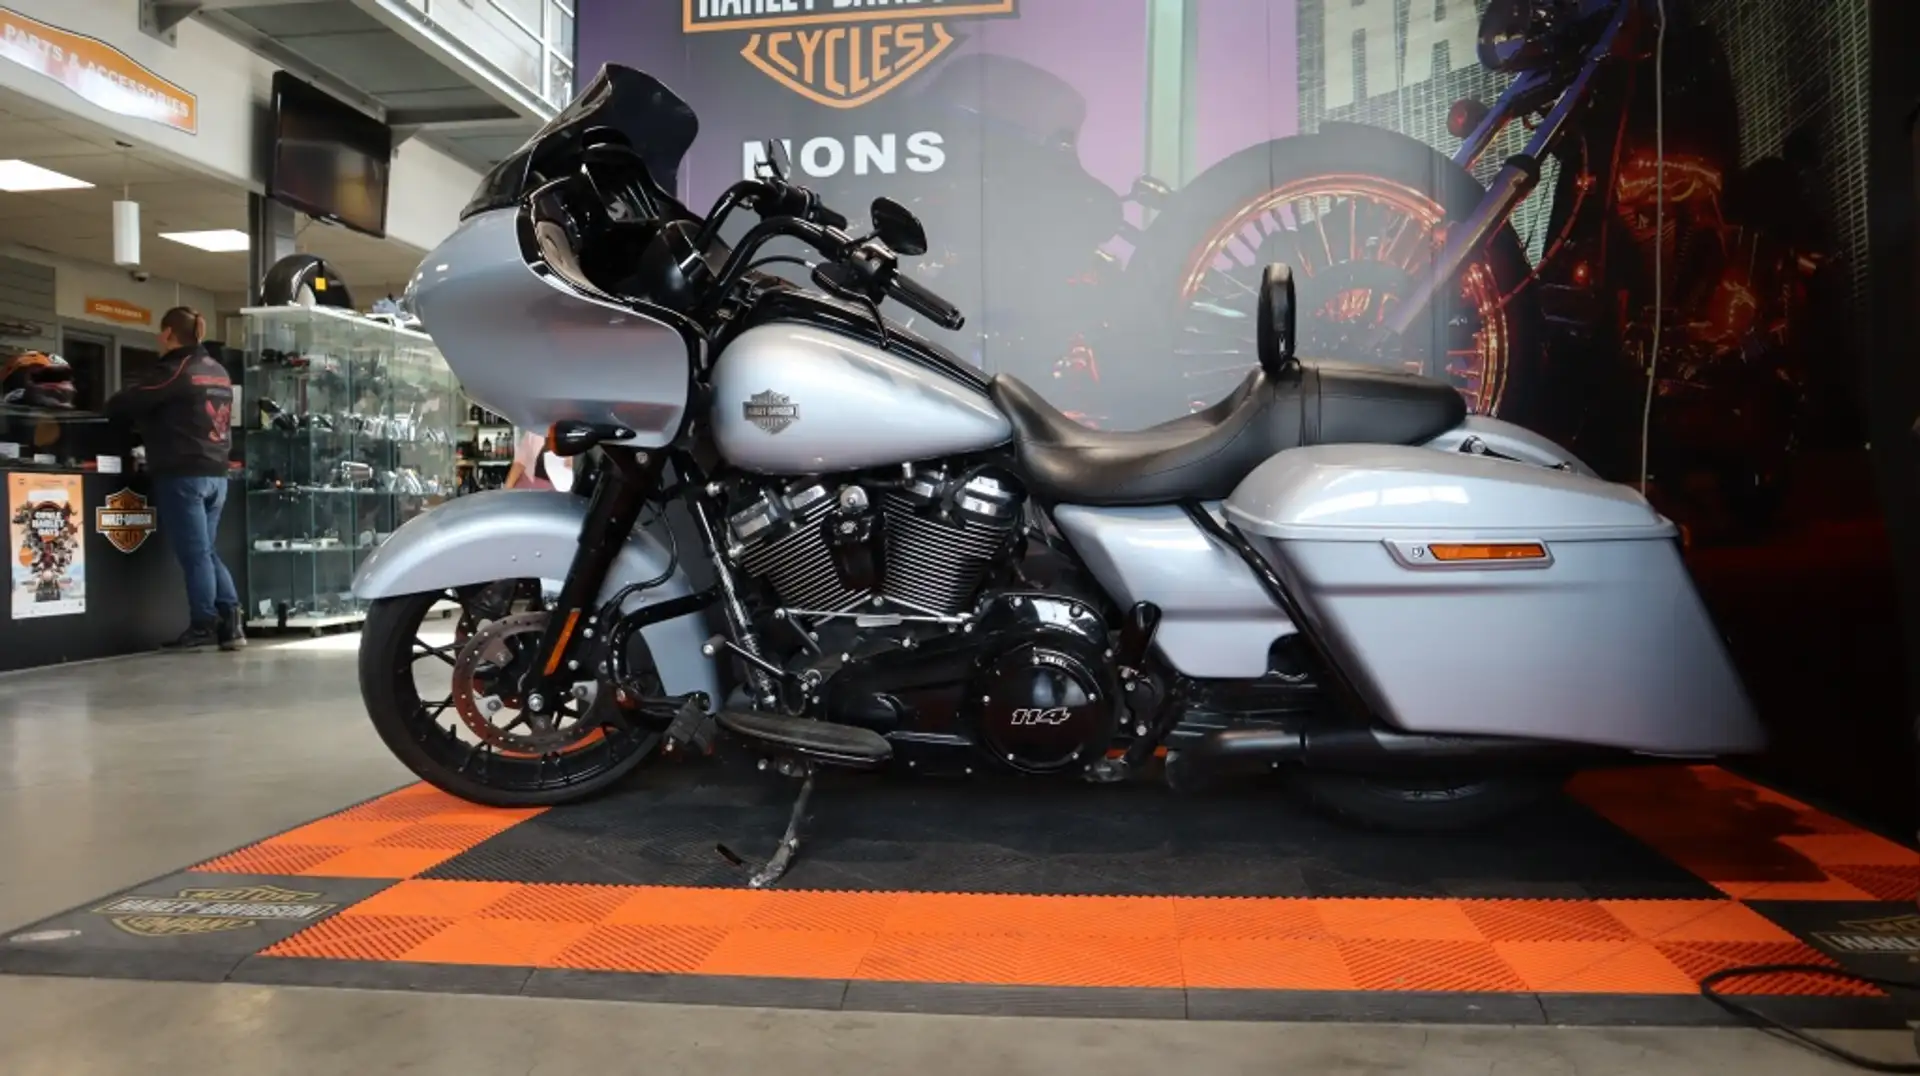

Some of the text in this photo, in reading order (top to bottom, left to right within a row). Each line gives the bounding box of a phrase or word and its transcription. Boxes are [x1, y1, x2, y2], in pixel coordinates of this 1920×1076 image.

[3, 23, 189, 117] PARTS & ACCESSORIES
[768, 24, 925, 96] CYCLES
[1011, 706, 1071, 725] 114
